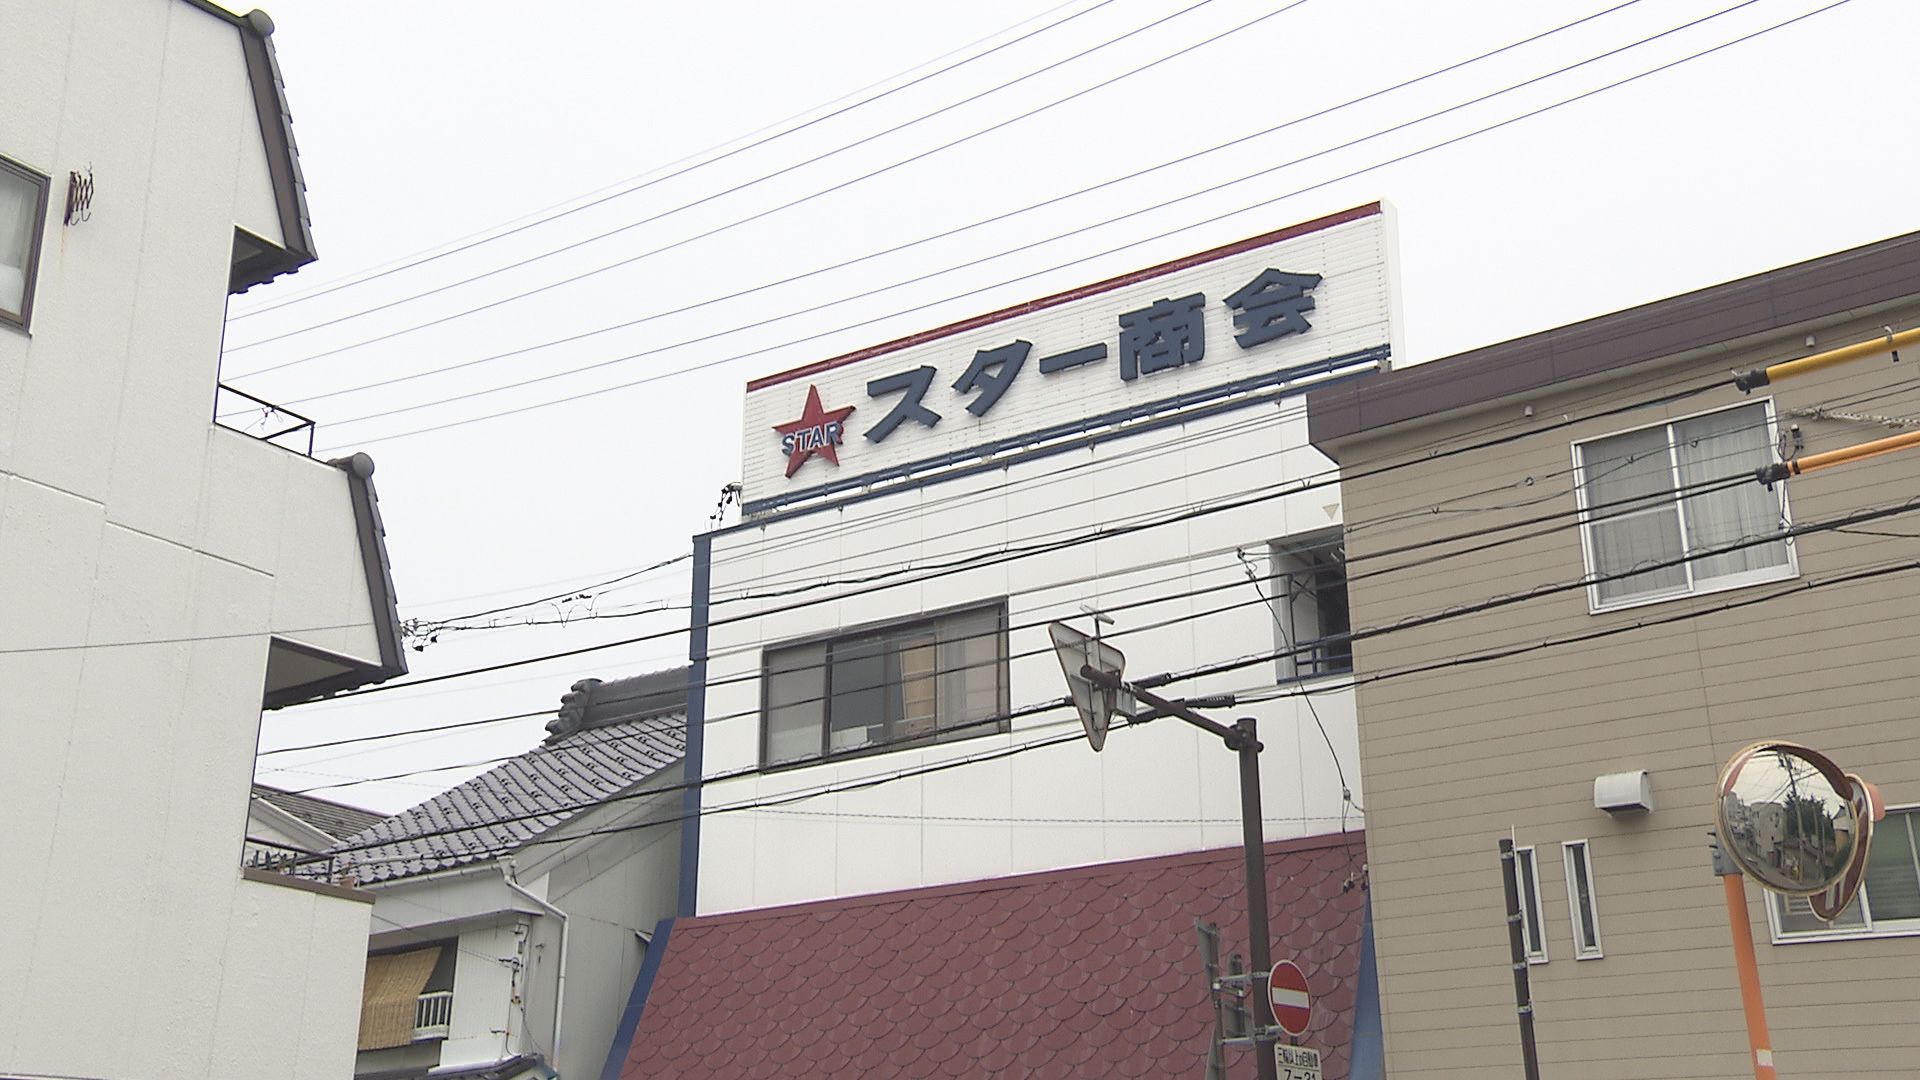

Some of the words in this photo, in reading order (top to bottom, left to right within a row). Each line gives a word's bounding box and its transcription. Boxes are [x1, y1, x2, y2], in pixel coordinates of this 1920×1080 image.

[864, 267, 1323, 443] スター商会
[782, 421, 843, 456] STAR
